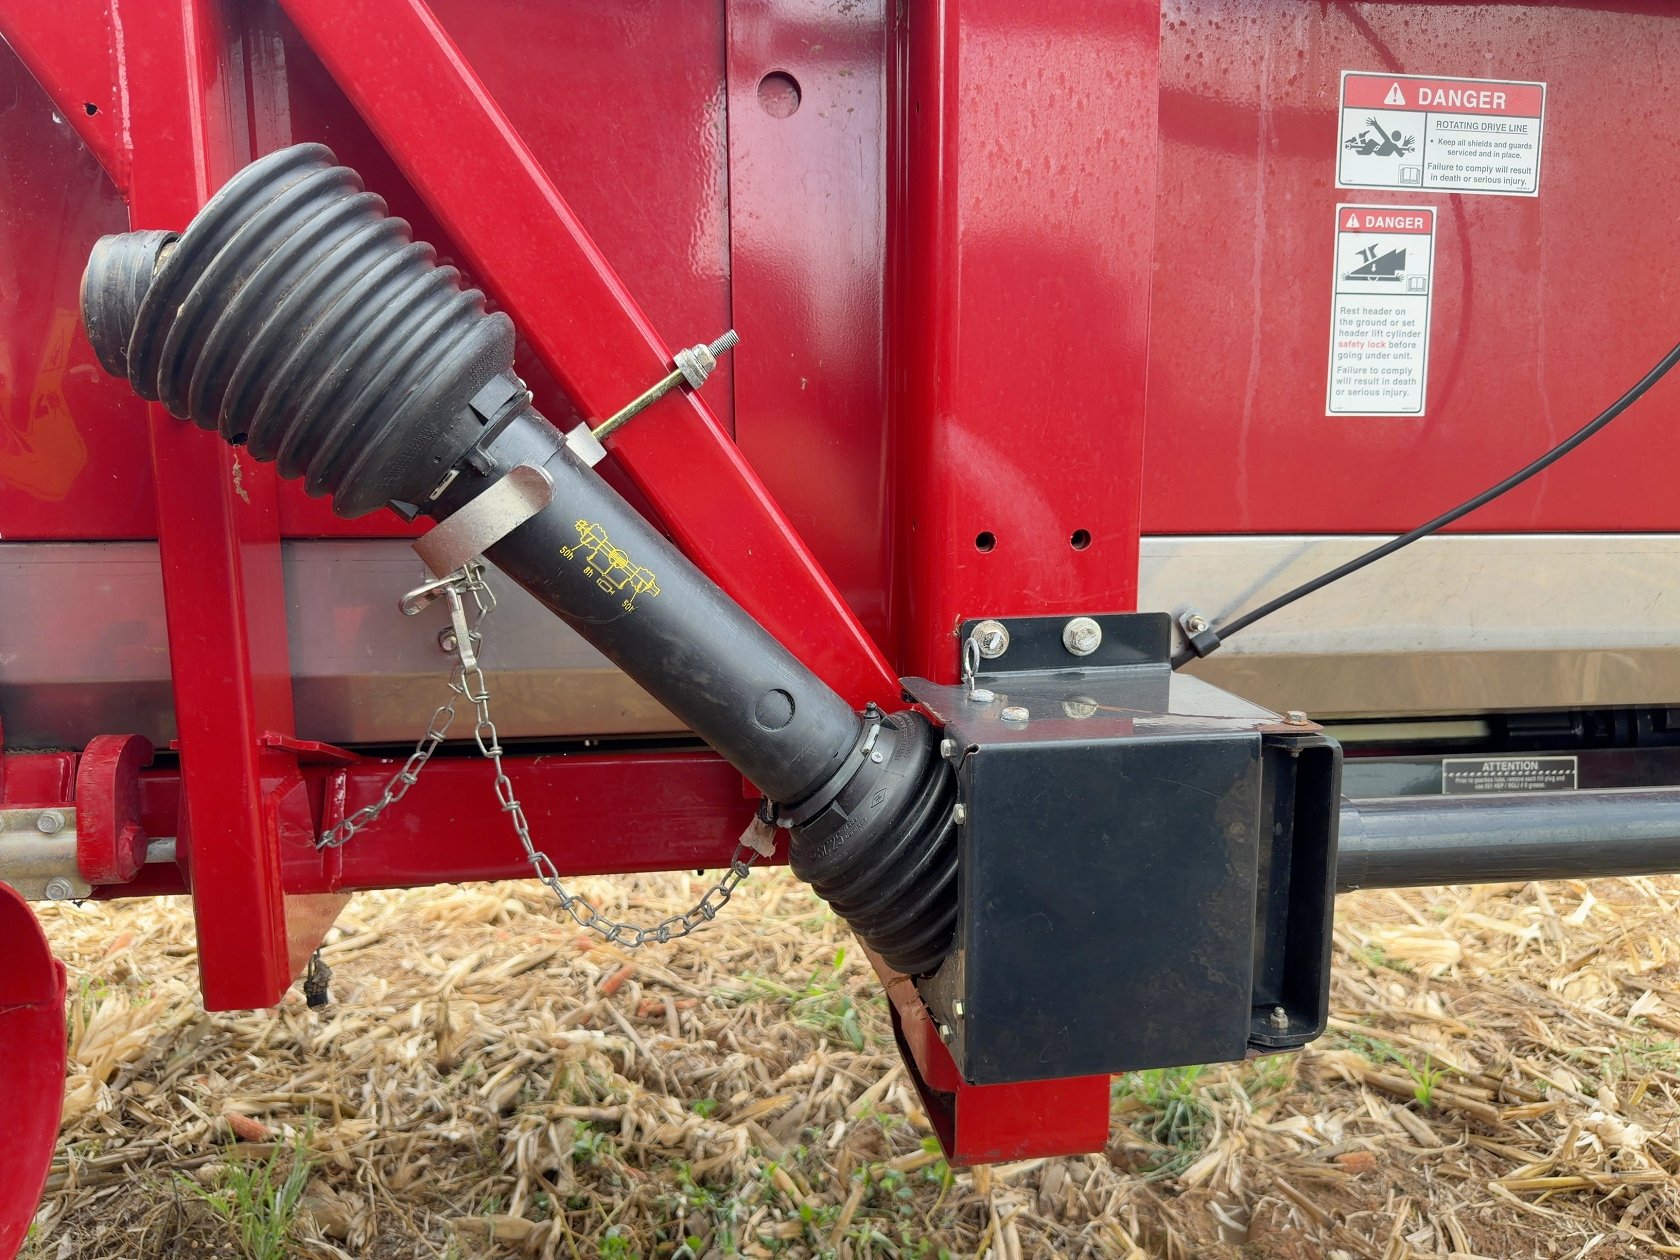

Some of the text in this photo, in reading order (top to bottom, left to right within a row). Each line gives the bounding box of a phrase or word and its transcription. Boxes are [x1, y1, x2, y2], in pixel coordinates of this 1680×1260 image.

[1418, 88, 1506, 109] DANGER
[1436, 121, 1528, 132] ROTATING DRIVE LINE
[1465, 165, 1493, 174] comply
[1503, 177, 1527, 186] injury.
[1365, 216, 1424, 229] DANGER
[1340, 307, 1360, 315] Rest
[1356, 319, 1387, 327] ground
[1386, 330, 1421, 339] cylinder
[1338, 341, 1364, 350] safety
[1338, 352, 1362, 361] going
[1381, 367, 1412, 376] comply
[1382, 389, 1409, 398] injury.
[560, 546, 574, 561] 50h
[1482, 761, 1538, 771] ATTENTION
